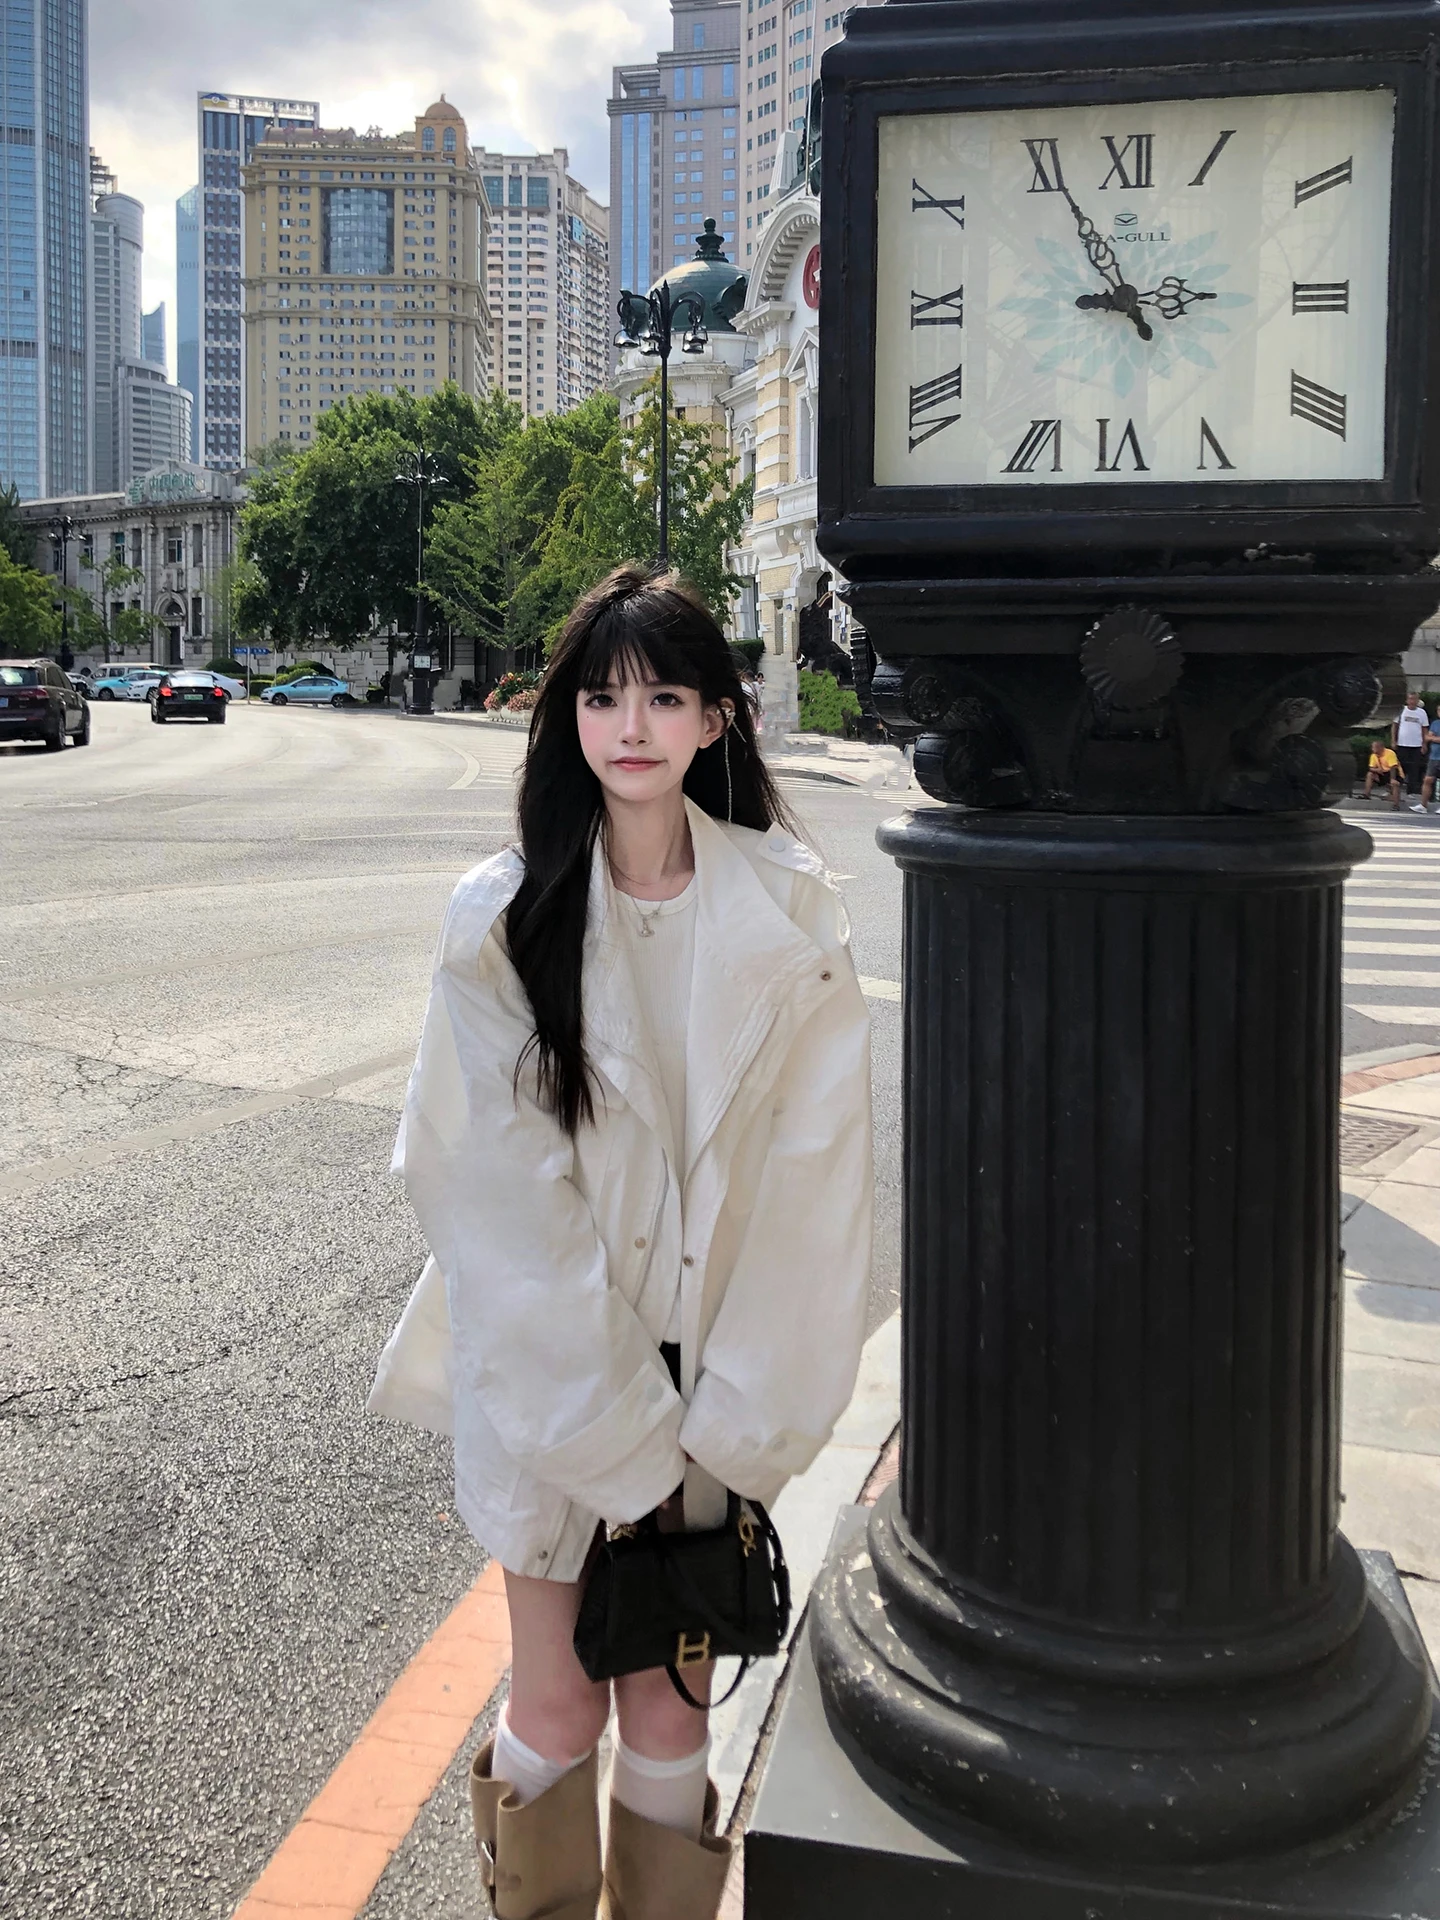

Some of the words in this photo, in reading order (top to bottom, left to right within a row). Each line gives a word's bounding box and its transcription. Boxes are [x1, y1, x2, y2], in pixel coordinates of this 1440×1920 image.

[1020, 138, 1067, 192] XI
[1099, 134, 1156, 189] XII
[1294, 155, 1353, 208] II
[912, 178, 965, 230] X
[1081, 232, 1171, 243] A-GULL
[911, 284, 964, 330] IX
[1292, 279, 1349, 316] III
[909, 363, 962, 453] VIII
[1290, 368, 1346, 442] IIII
[1000, 419, 1063, 473] VII
[1095, 418, 1150, 471] VI
[1197, 417, 1237, 470] V
